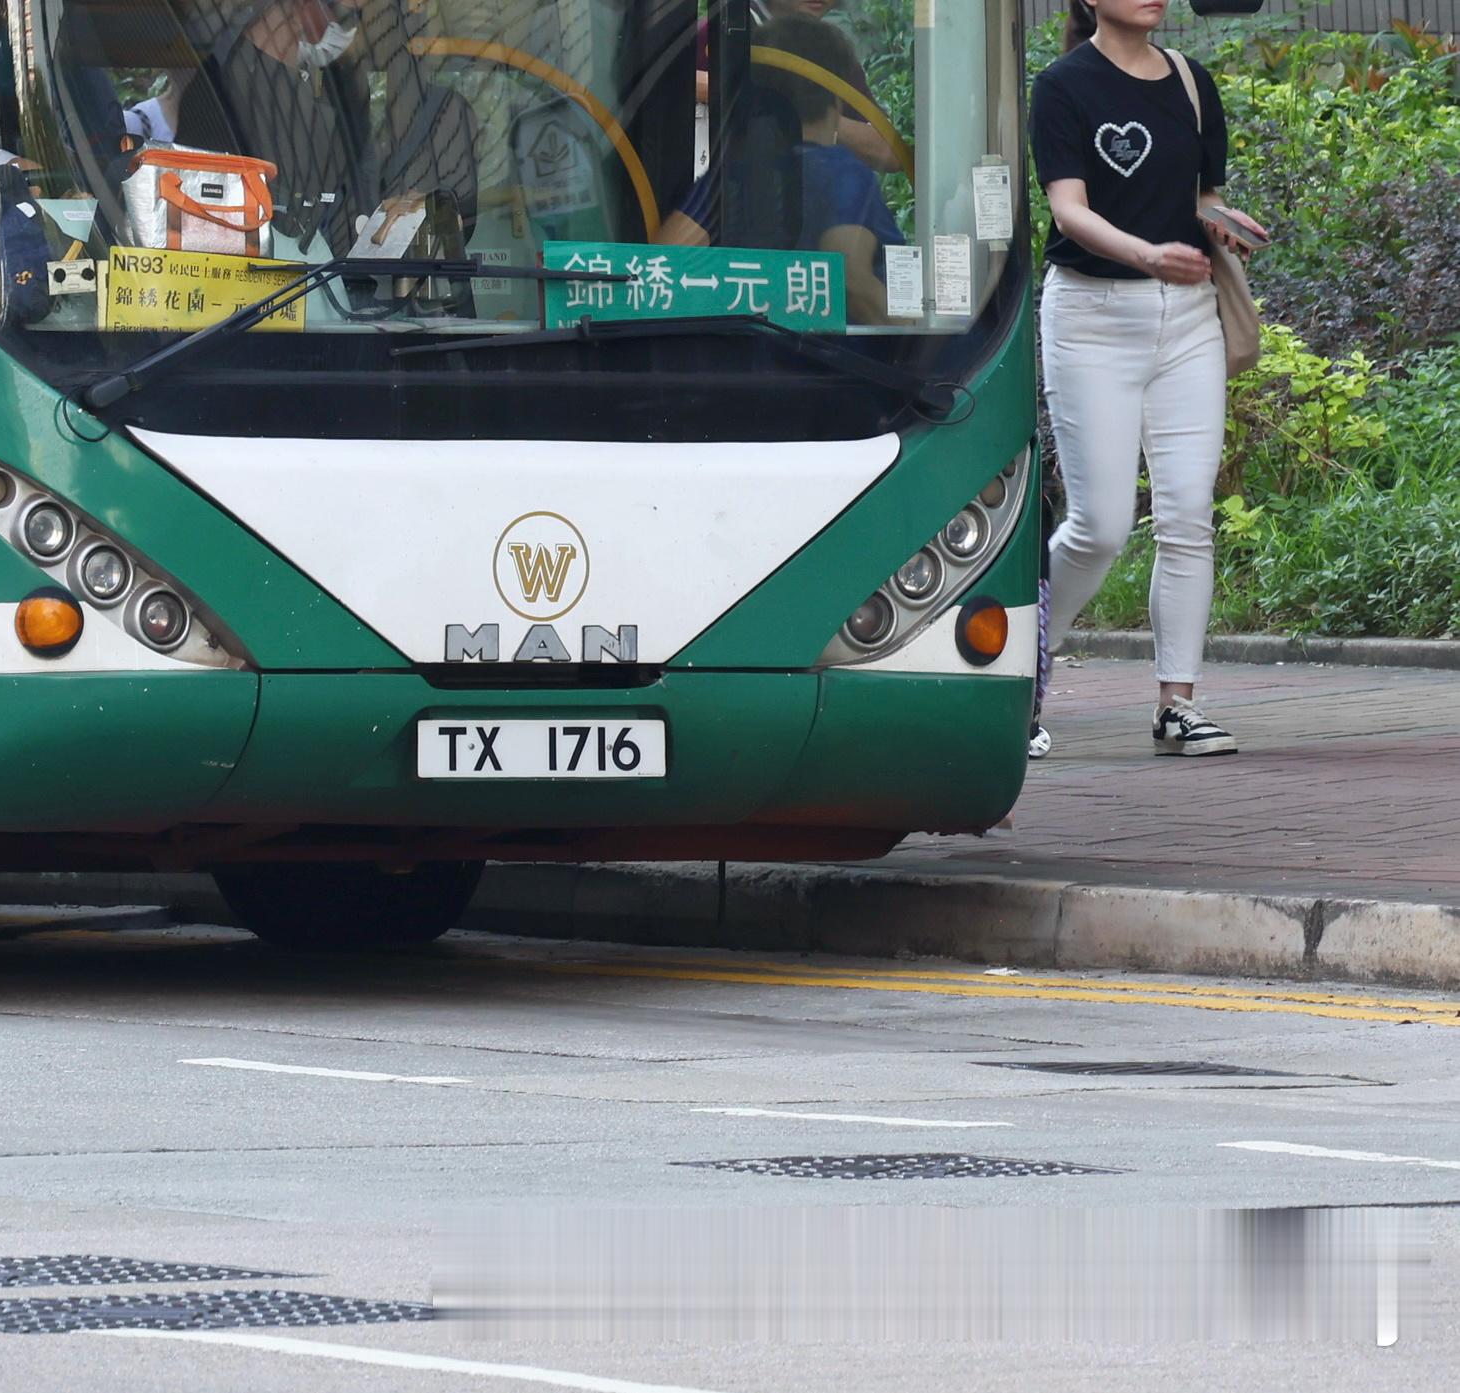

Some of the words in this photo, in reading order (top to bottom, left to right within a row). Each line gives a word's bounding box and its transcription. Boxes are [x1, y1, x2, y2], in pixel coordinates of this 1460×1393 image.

[113, 254, 163, 275] NR93
[508, 542, 577, 603] W
[444, 623, 638, 663] MAN
[438, 726, 503, 772] TX
[548, 726, 641, 772] 1716
